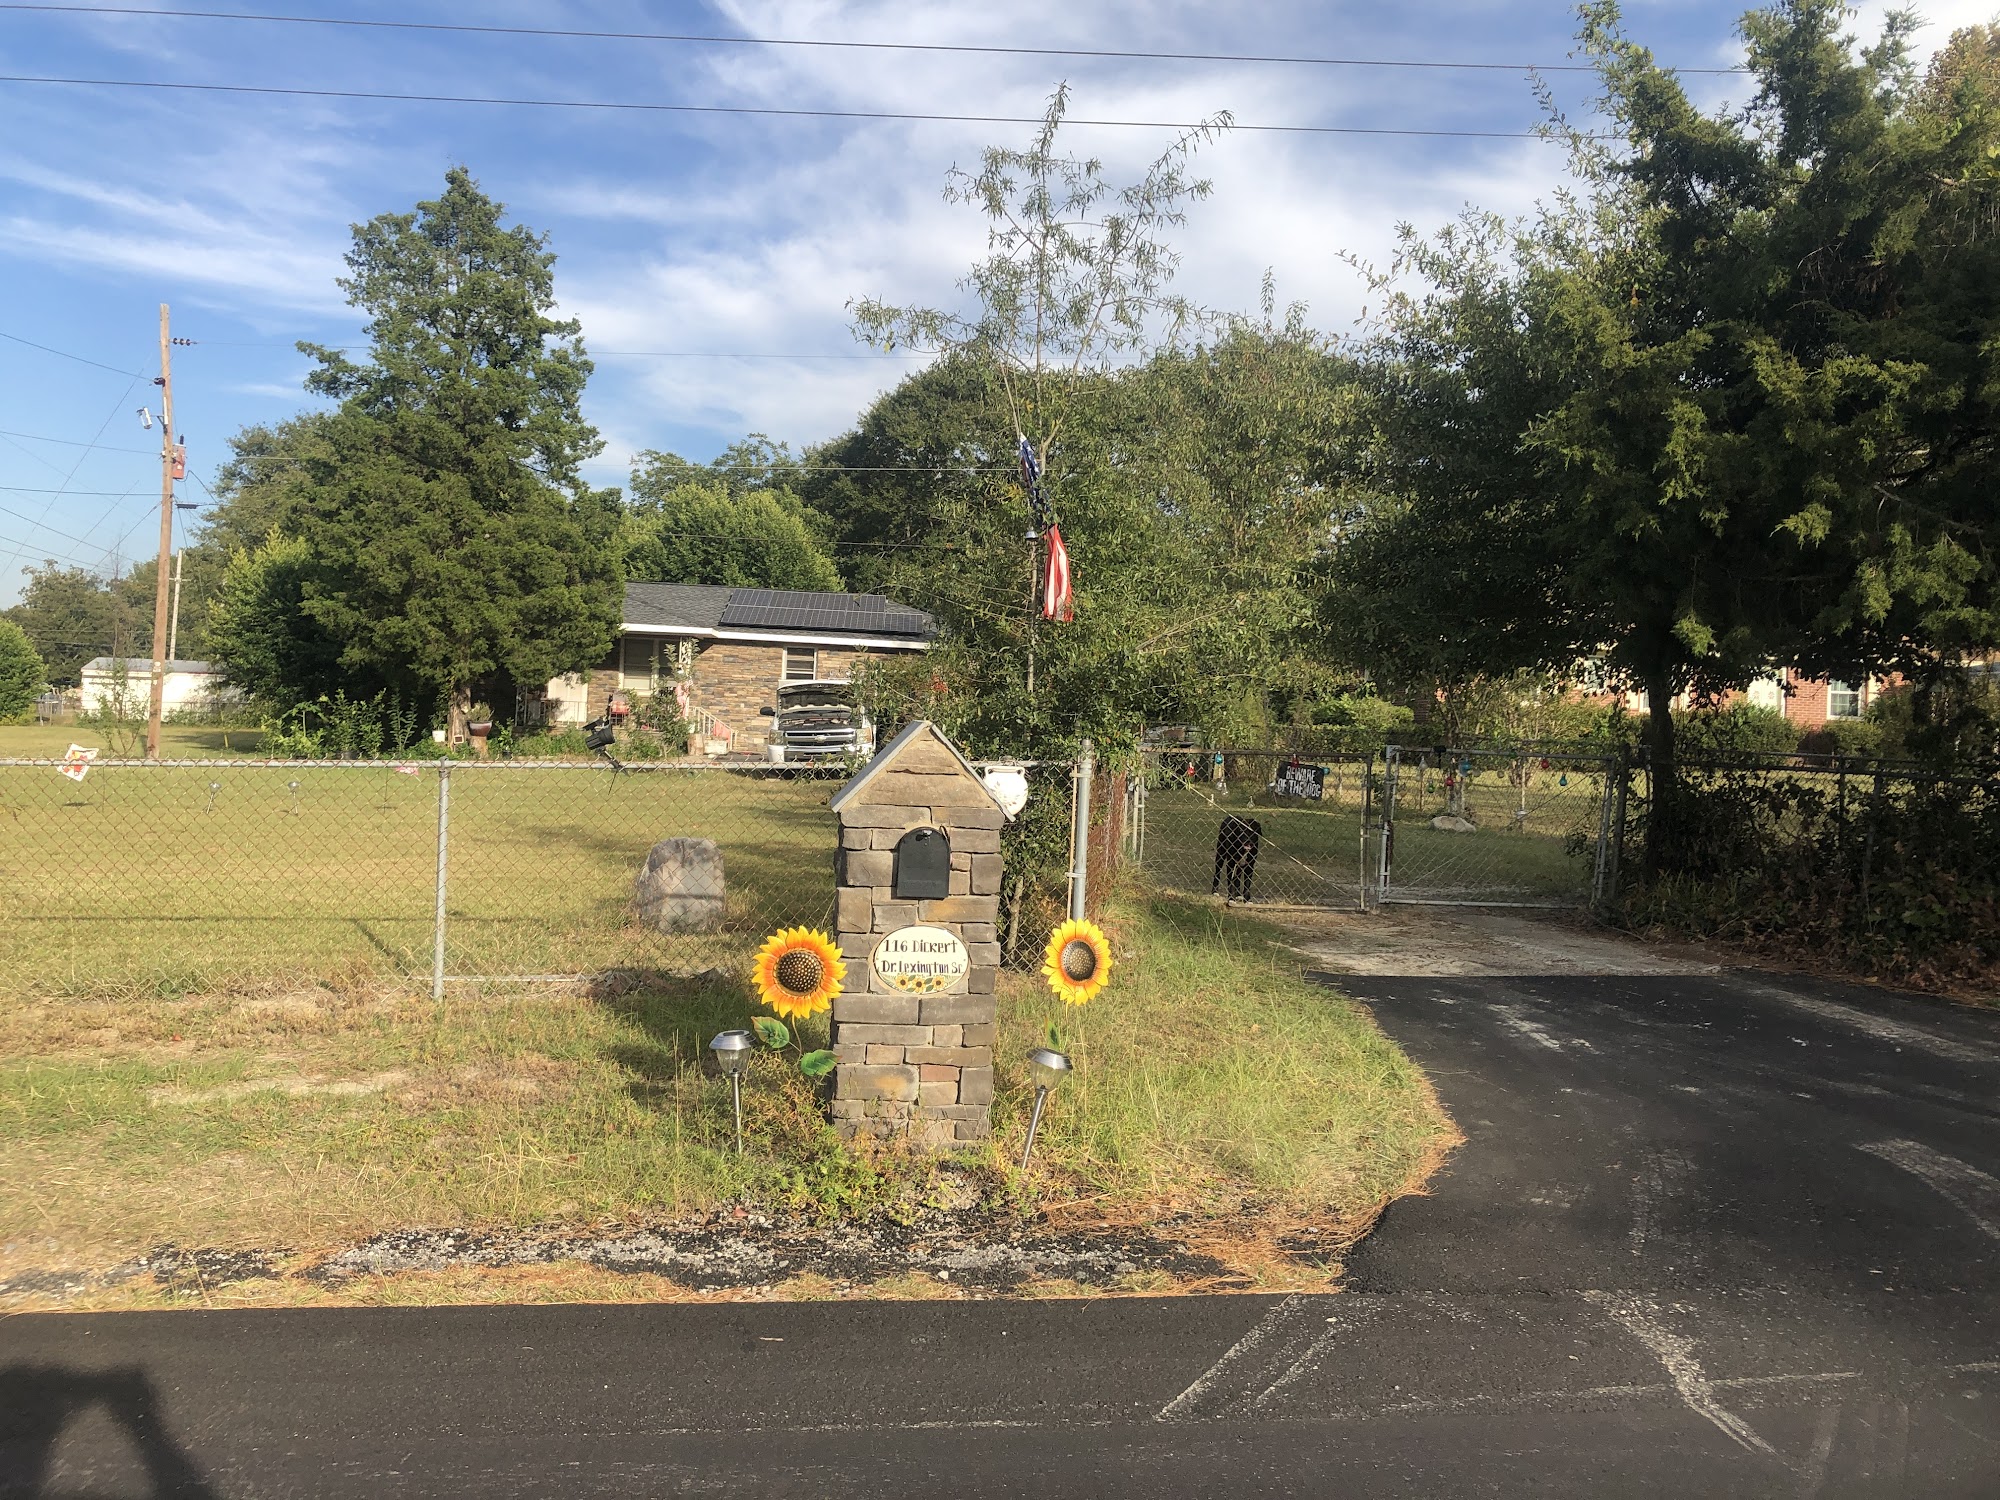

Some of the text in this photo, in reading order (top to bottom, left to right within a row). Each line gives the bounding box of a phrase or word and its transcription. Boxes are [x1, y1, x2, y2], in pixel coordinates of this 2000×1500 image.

[1286, 766, 1316, 783] BEWARE
[1278, 778, 1321, 797] OF THE DOG
[883, 939, 957, 953] 116 Dickert
